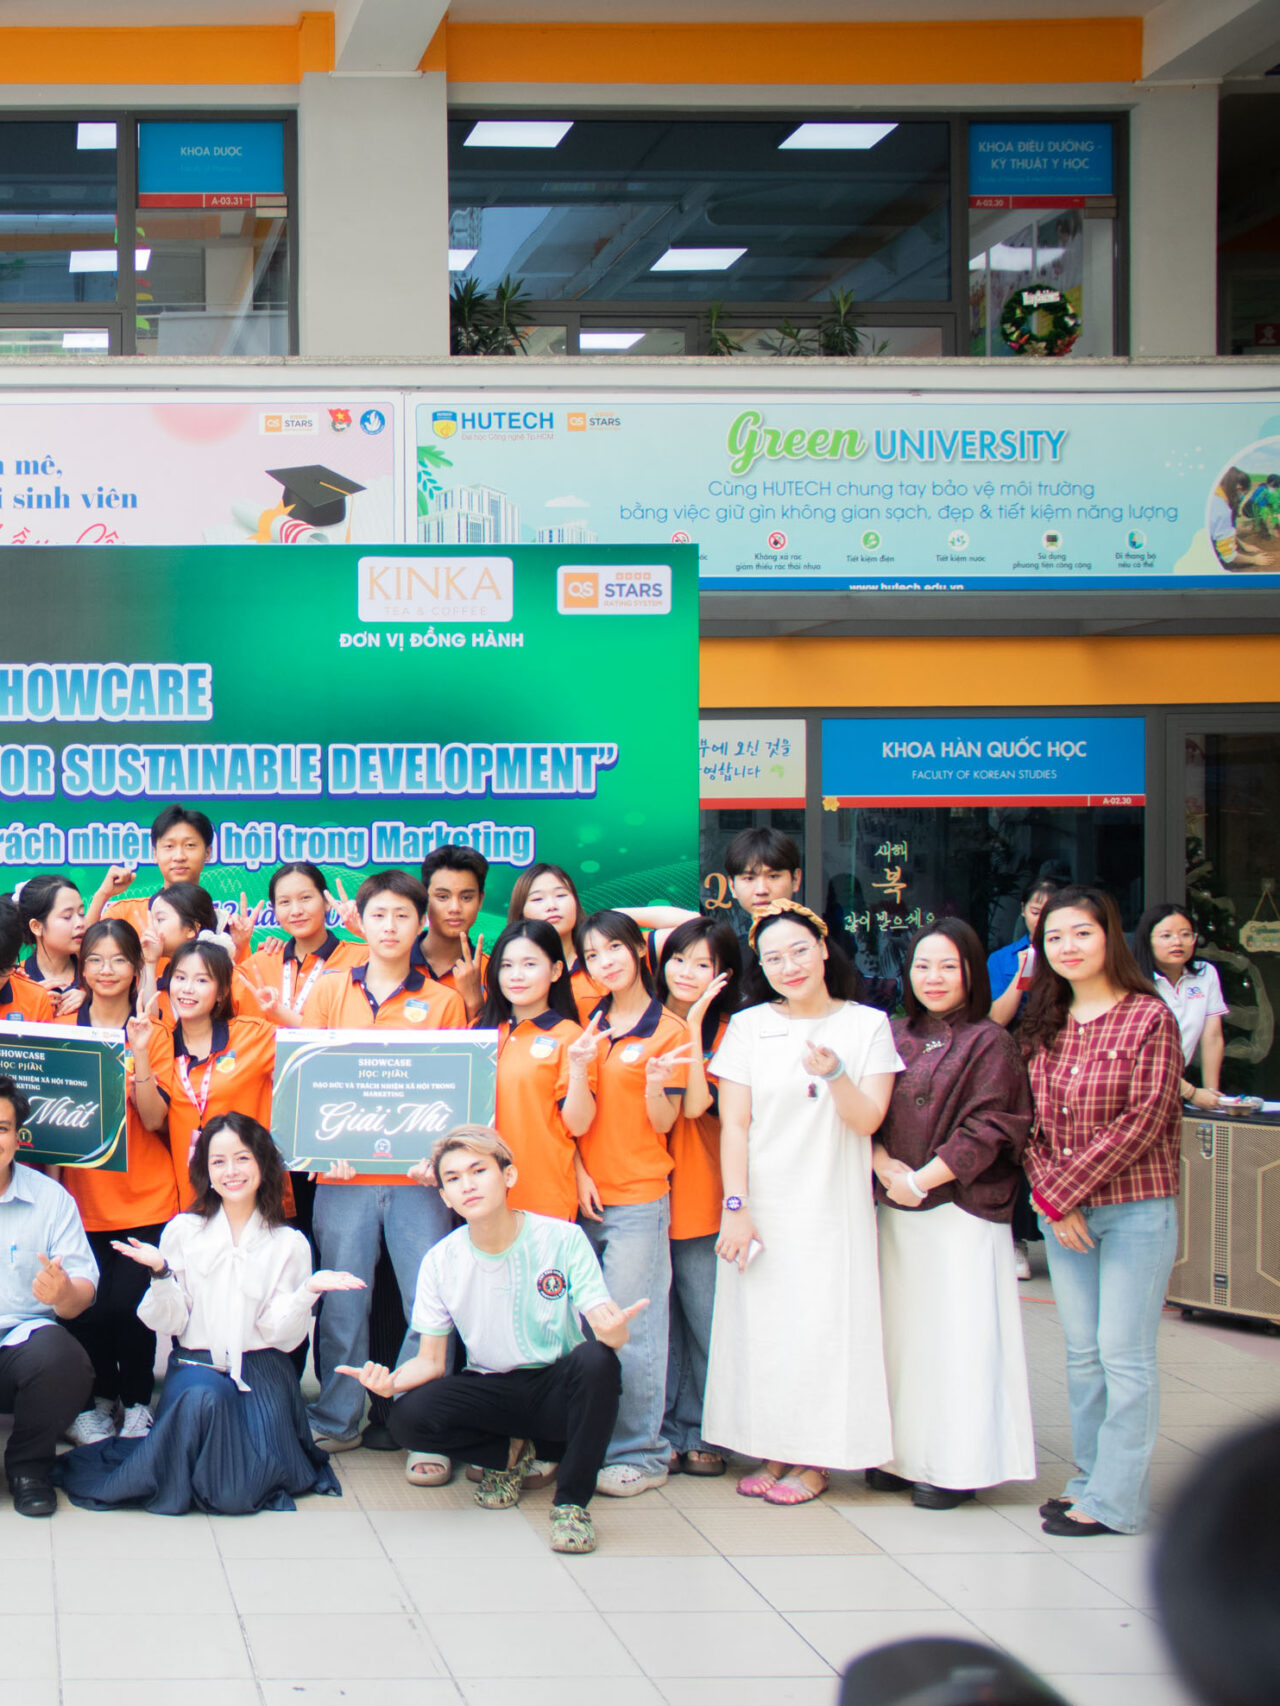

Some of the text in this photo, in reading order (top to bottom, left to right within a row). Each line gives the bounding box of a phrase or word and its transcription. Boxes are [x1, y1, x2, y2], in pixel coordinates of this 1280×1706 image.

[181, 147, 210, 156] KHOA
[978, 141, 1014, 152] KHOA
[461, 411, 554, 430] HUTECH
[589, 418, 621, 426] STARS
[727, 410, 1066, 475] Green UNIVERSITY
[15, 453, 63, 478] mê,
[13, 487, 70, 509] sinh
[81, 487, 138, 509] viên
[708, 479, 1095, 500] Cùng HUTECH chung tay bảo vệ môi trường
[620, 502, 1178, 524] bằng việc giữ gìn không gian sạch, đẹp & tiết kiệm năng lượng
[368, 566, 502, 600] KINKA
[568, 582, 663, 599] QS STARS
[385, 606, 487, 616] TEA COFFEE
[339, 626, 524, 651] ĐƠN VỊ ĐỒNG HÀNH
[882, 736, 1087, 761] KHOA HÀN QUỐC HỌC
[63, 746, 320, 794] SUSTAINABLE
[912, 770, 1058, 779] FACULTY OF KOREAN STUDIES
[224, 825, 274, 867] hội
[278, 828, 365, 864] trong
[376, 822, 532, 864] Marketing
[875, 840, 908, 863] 새해
[872, 866, 907, 904] 복
[358, 1058, 412, 1068] SHOWCASE
[23, 1095, 100, 1130] Nhất
[315, 1100, 390, 1141] Giải
